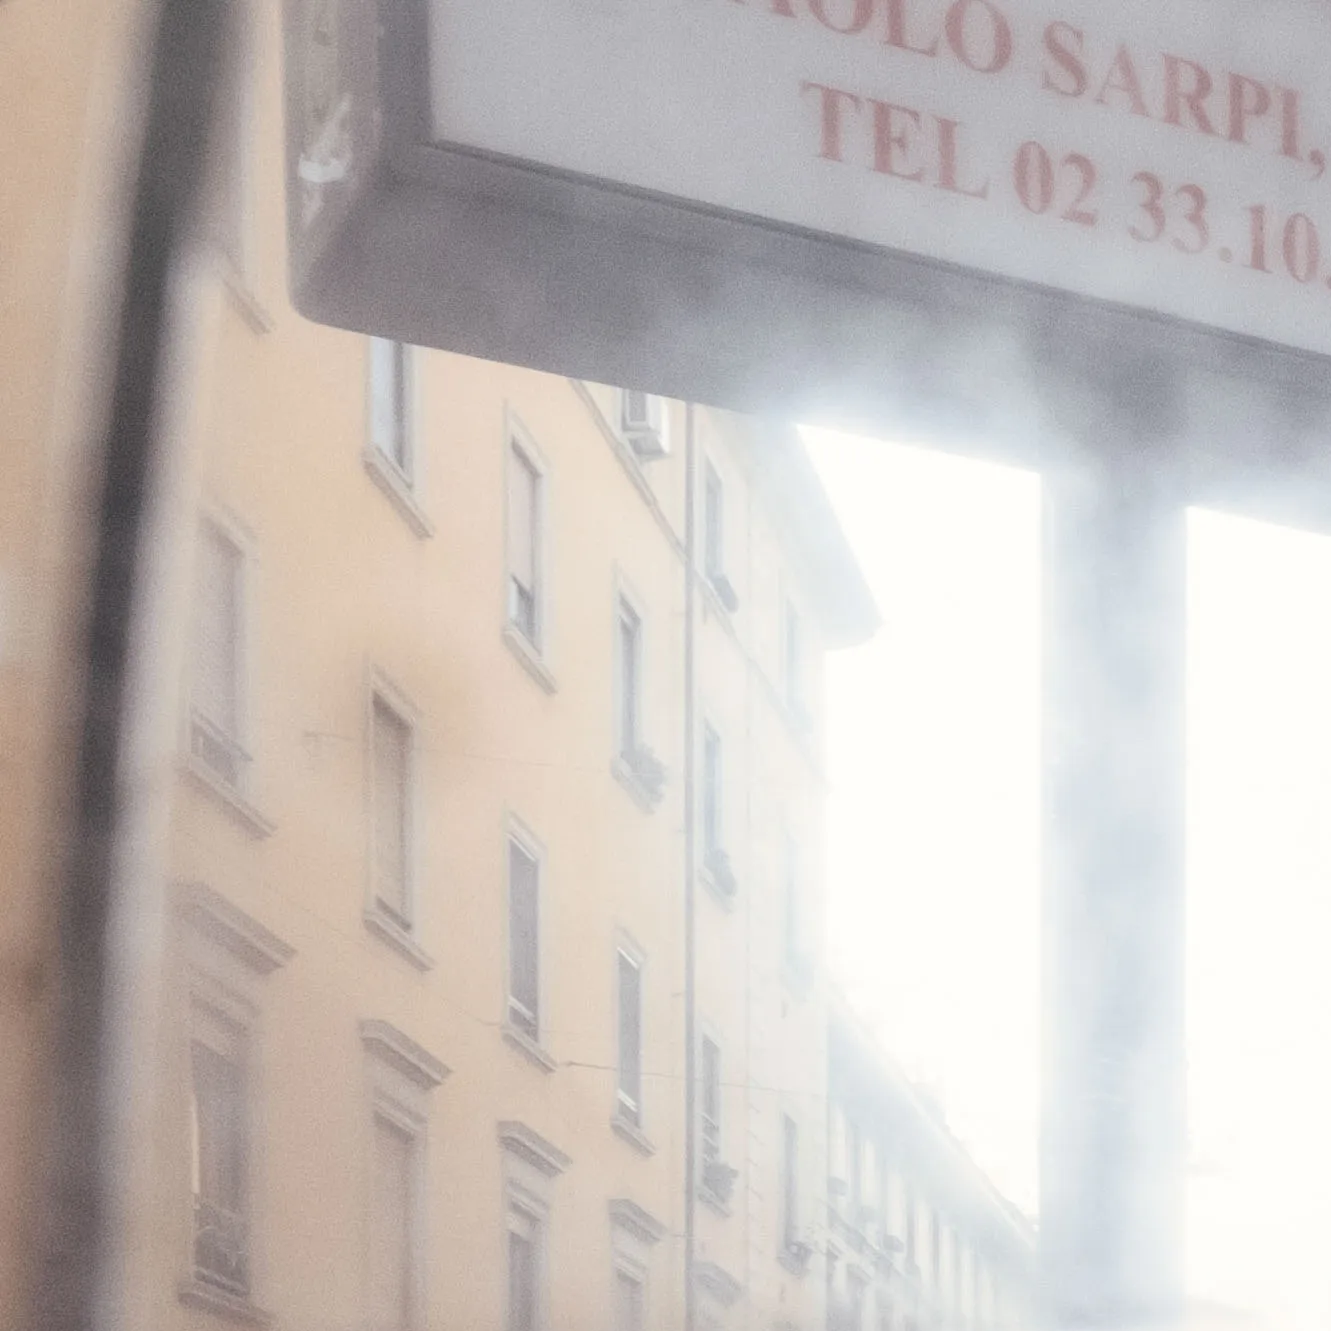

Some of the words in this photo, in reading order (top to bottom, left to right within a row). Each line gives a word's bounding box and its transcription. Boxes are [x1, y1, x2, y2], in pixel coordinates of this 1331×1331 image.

[801, 80, 990, 201] TEL
[1013, 141, 1100, 227] 02
[1041, 20, 1326, 180] SARPI,
